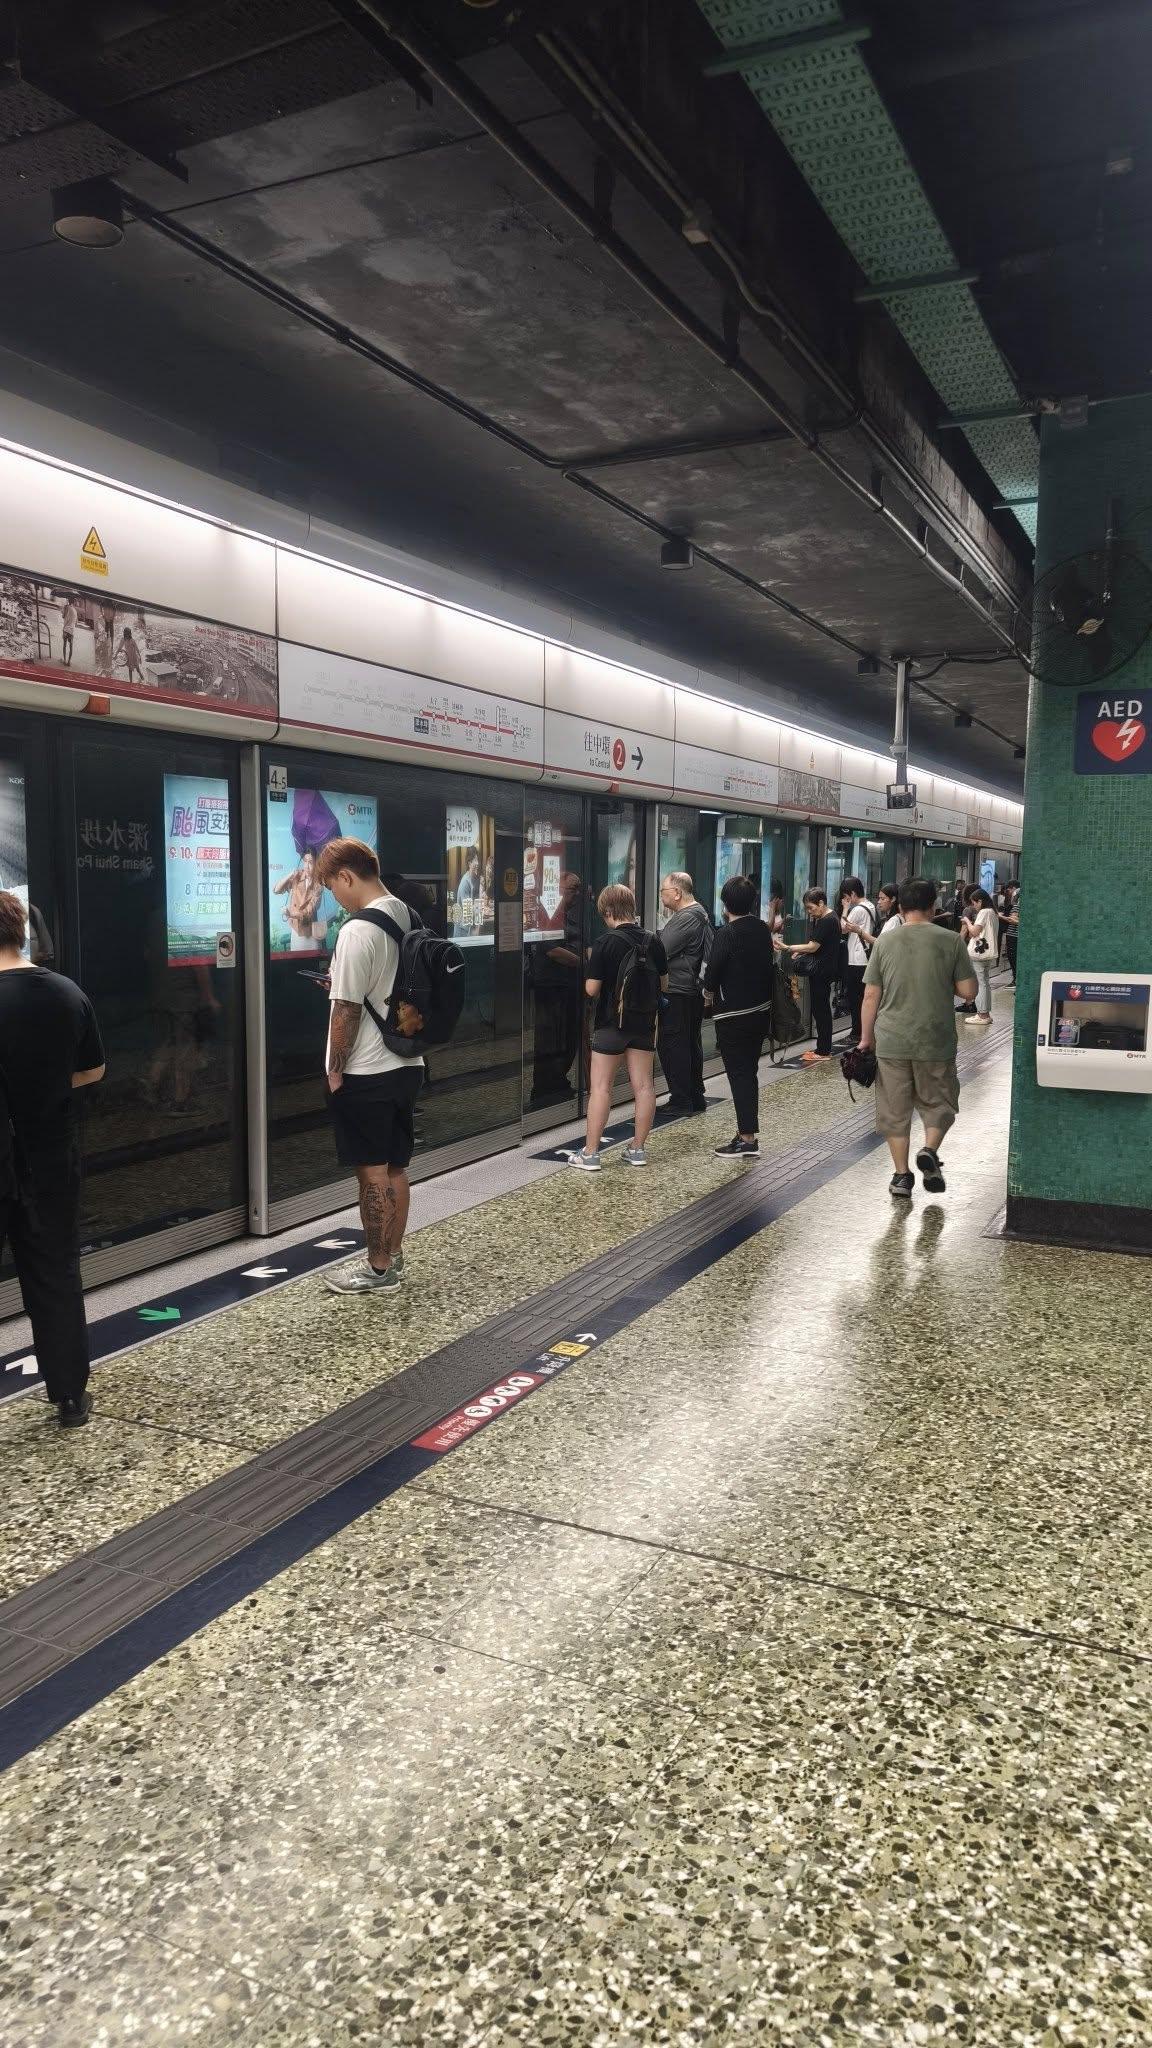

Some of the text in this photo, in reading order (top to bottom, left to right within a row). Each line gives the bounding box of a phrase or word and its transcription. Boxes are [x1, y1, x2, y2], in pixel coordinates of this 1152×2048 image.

[1097, 700, 1142, 717] AED
[584, 731, 610, 755] 往中環
[595, 758, 610, 769] Central
[616, 744, 623, 766] 2
[356, 806, 373, 816] MTR
